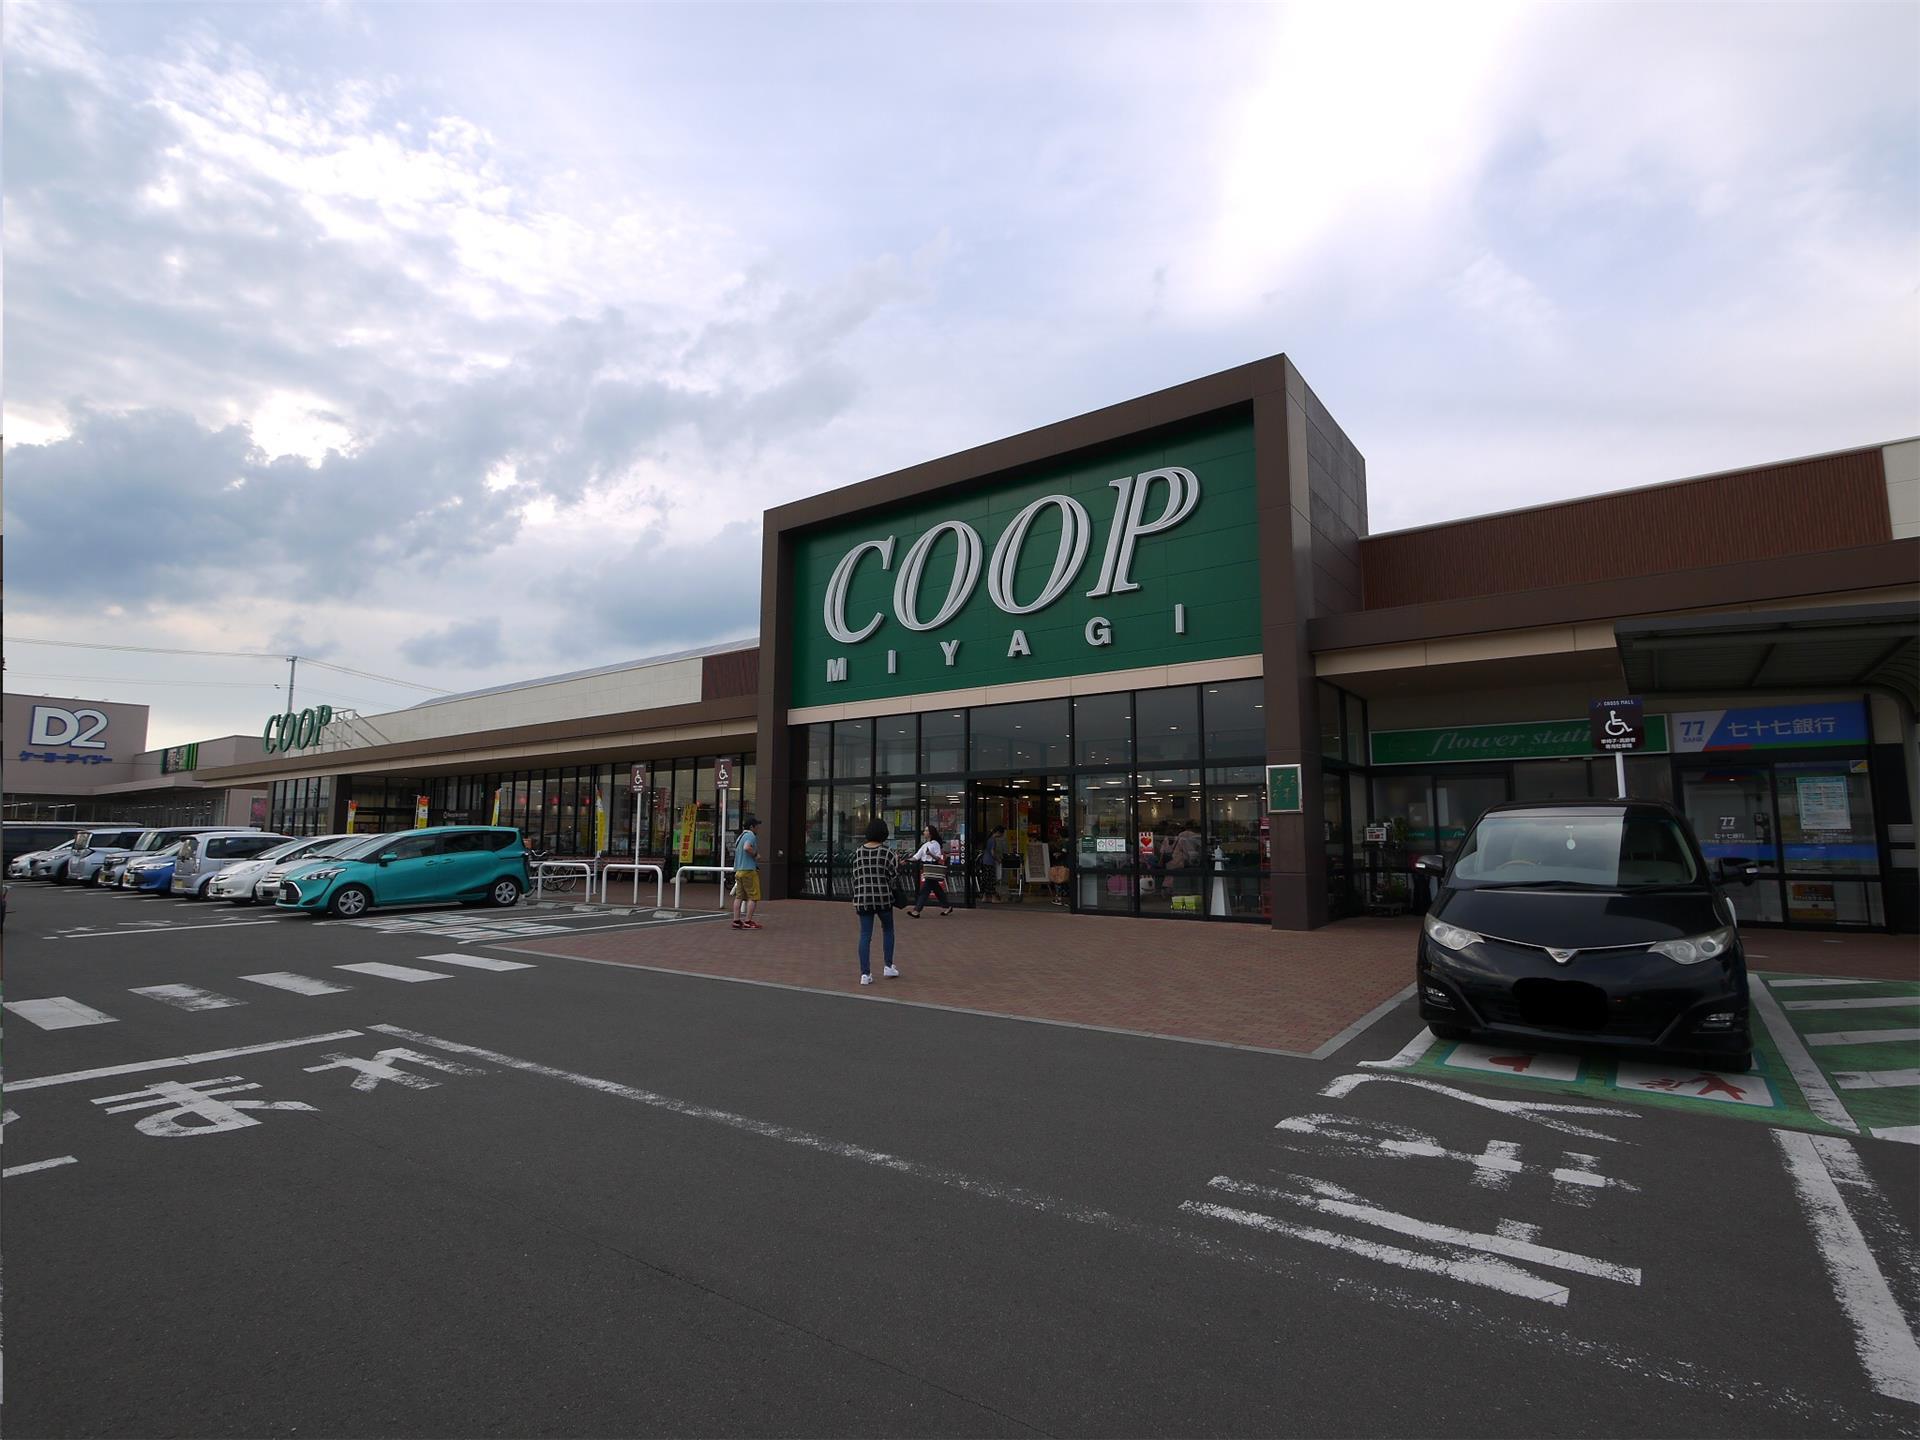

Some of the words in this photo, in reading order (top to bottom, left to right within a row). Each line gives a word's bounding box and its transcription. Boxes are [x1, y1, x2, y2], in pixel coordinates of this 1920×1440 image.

[823, 466, 1200, 645] COOP
[826, 603, 1186, 683] MIYAGI
[29, 705, 109, 750] D2
[262, 704, 333, 755] COOP
[1426, 731, 1525, 757] flower
[1530, 725, 1592, 745] stati
[1679, 721, 1706, 737] 77
[1727, 716, 1836, 738] 七十七銀行
